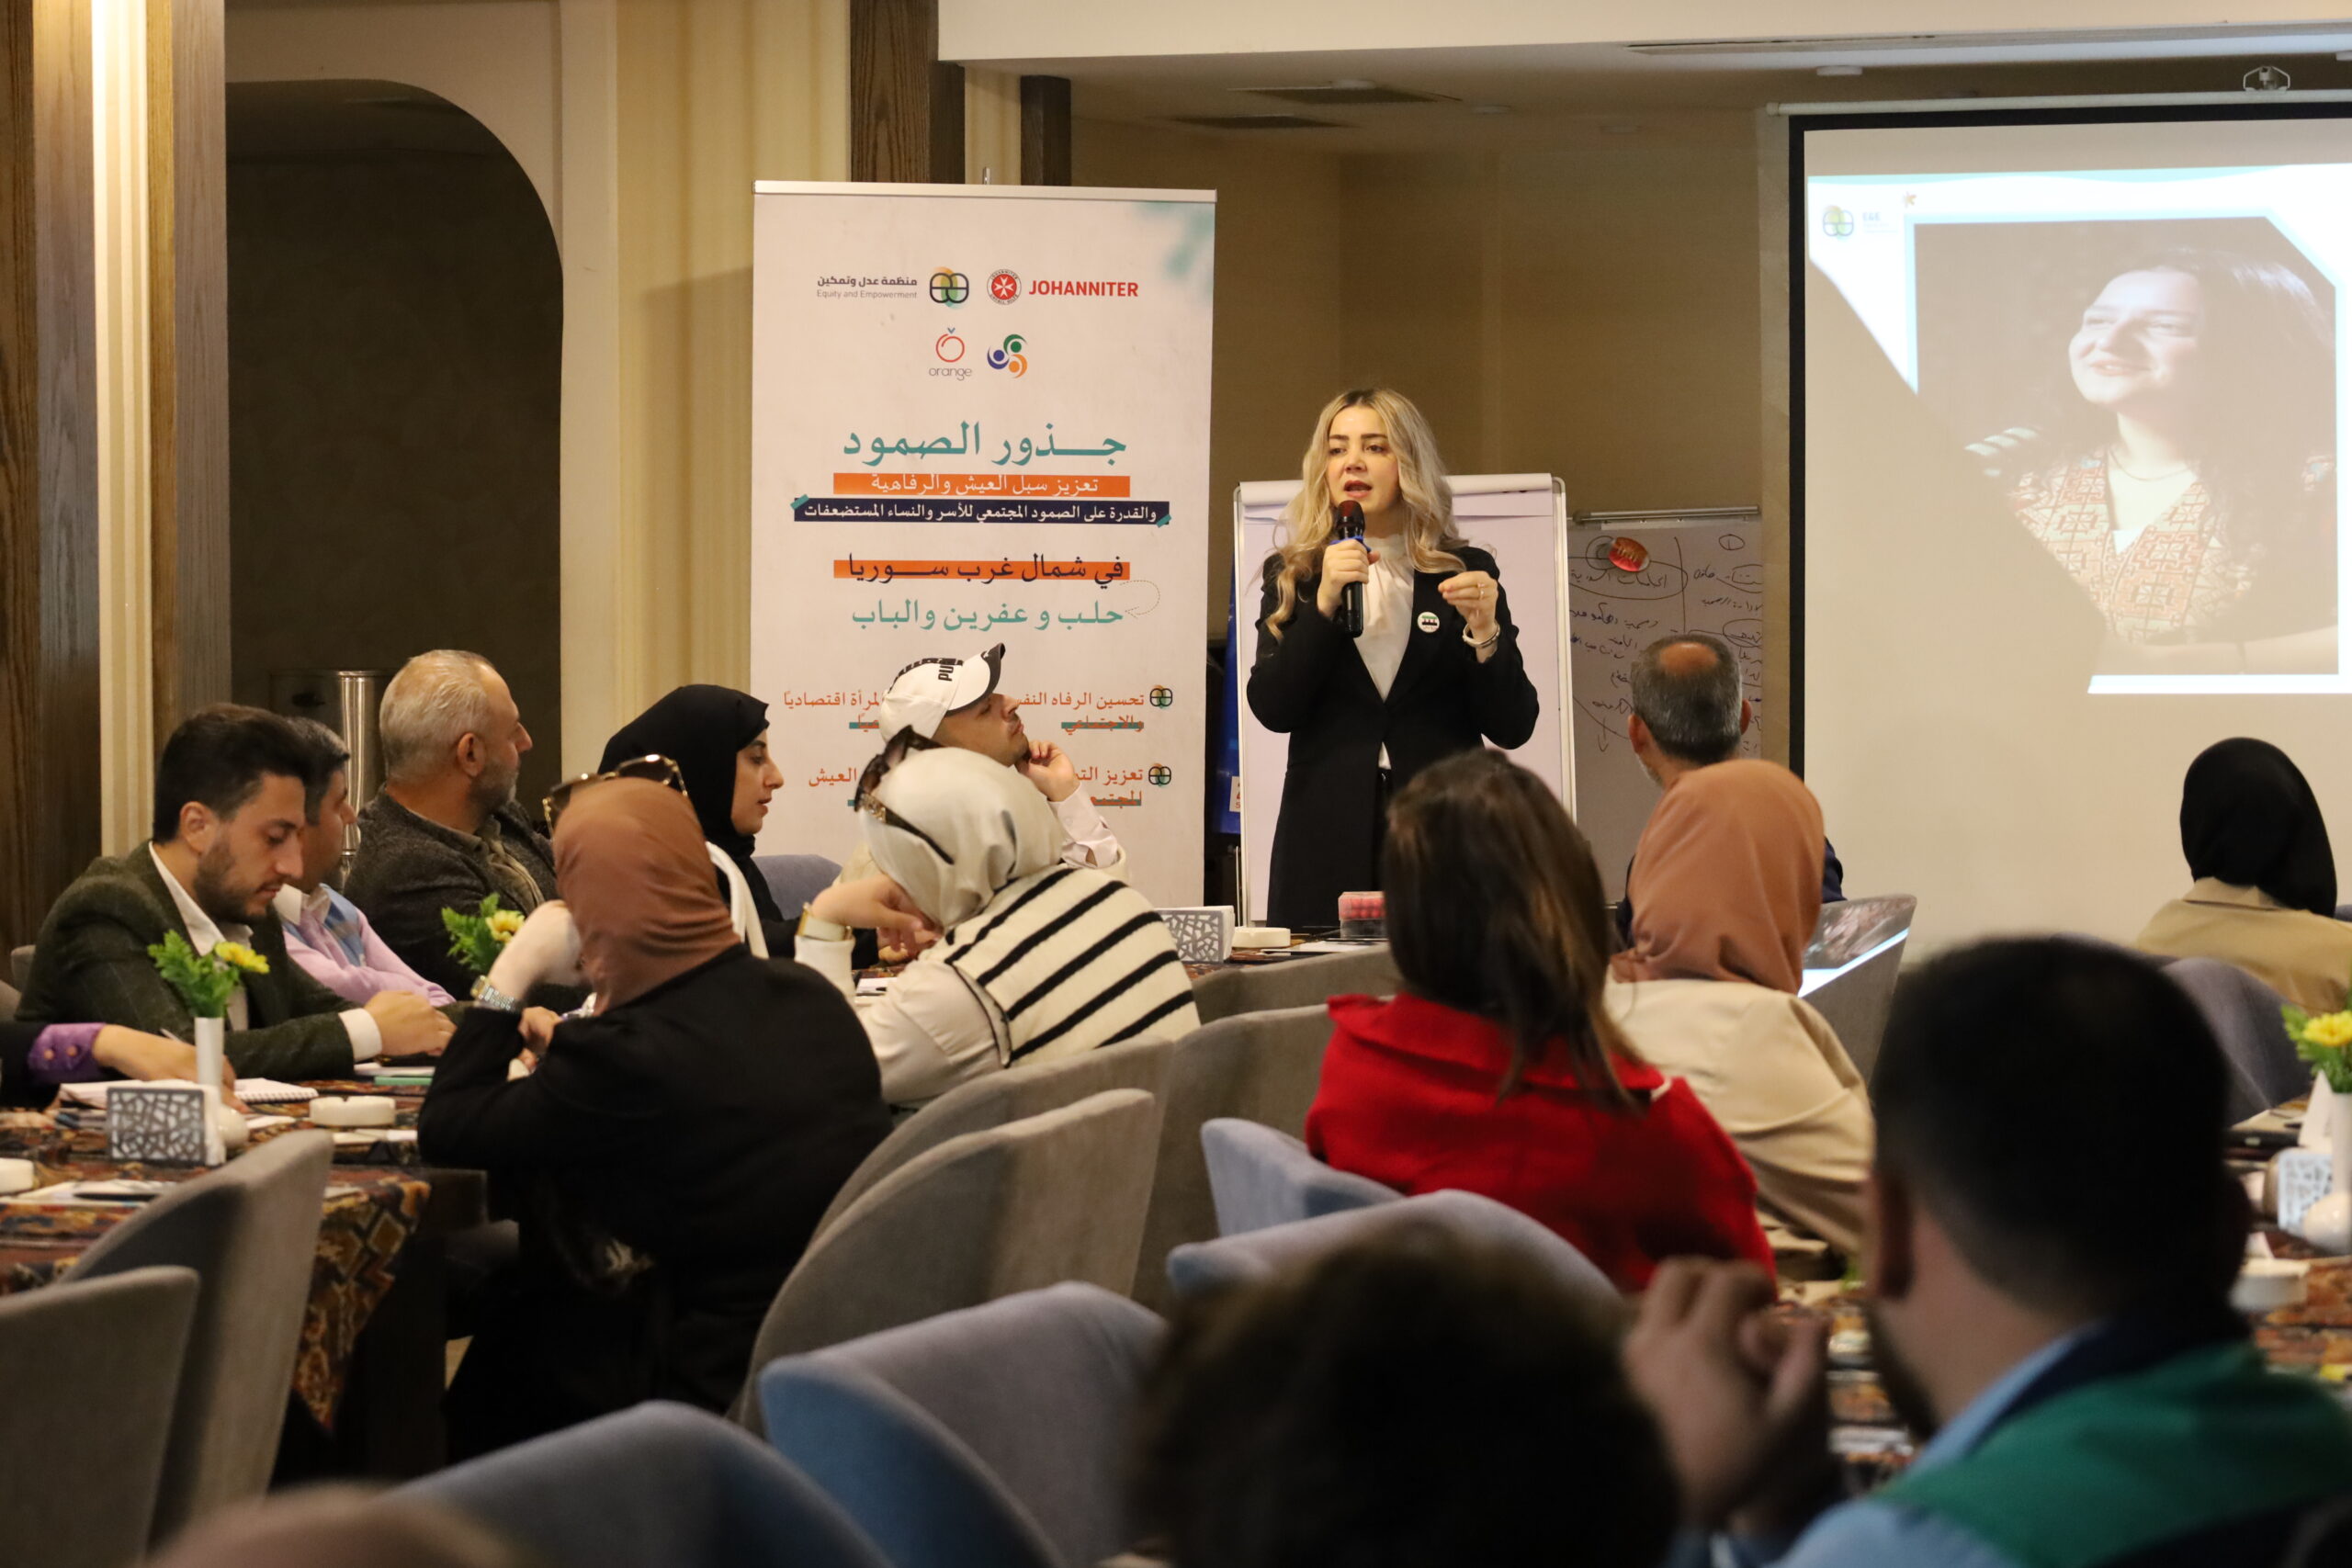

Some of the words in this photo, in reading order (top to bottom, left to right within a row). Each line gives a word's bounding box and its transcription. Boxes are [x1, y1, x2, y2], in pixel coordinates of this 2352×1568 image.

[817, 276, 856, 288] وتمكين
[858, 276, 879, 288] عدل
[881, 276, 918, 287] منظمة
[1028, 279, 1139, 298] JOHANNITER
[816, 289, 842, 299] Equity
[842, 289, 858, 299] and
[860, 290, 918, 300] Empowerment
[928, 367, 973, 381] orange
[843, 420, 980, 467] الصمود
[991, 423, 1127, 467] جذور
[871, 473, 951, 496] والرفاهية
[956, 474, 1008, 496] العيش
[1012, 475, 1048, 495] سبل
[1052, 478, 1099, 498] تعزيز
[804, 502, 884, 519] المستضعفات
[888, 503, 933, 521] والنساء
[935, 502, 974, 522] للأسر
[976, 504, 1027, 525] المجتمعي
[1031, 505, 1080, 523] الصمود
[1083, 505, 1106, 523] على
[1109, 506, 1158, 523] والقدرة
[848, 551, 949, 584] سوريا
[957, 557, 1014, 585] غرب
[1021, 552, 1086, 582] شمال
[1094, 555, 1124, 590] في
[852, 598, 936, 630] والباب
[943, 603, 1028, 632] عفرين
[1034, 609, 1050, 631] و
[1057, 600, 1124, 630] حلب
[937, 664, 955, 682] PU
[850, 690, 880, 711] لمرأة
[1019, 692, 1047, 705] النف
[1051, 691, 1091, 710] الرفاه
[1096, 694, 1145, 710] تحسين
[1064, 715, 1145, 736] والاجتماعي
[808, 768, 858, 787] العيش
[1102, 769, 1144, 785] تعزيز
